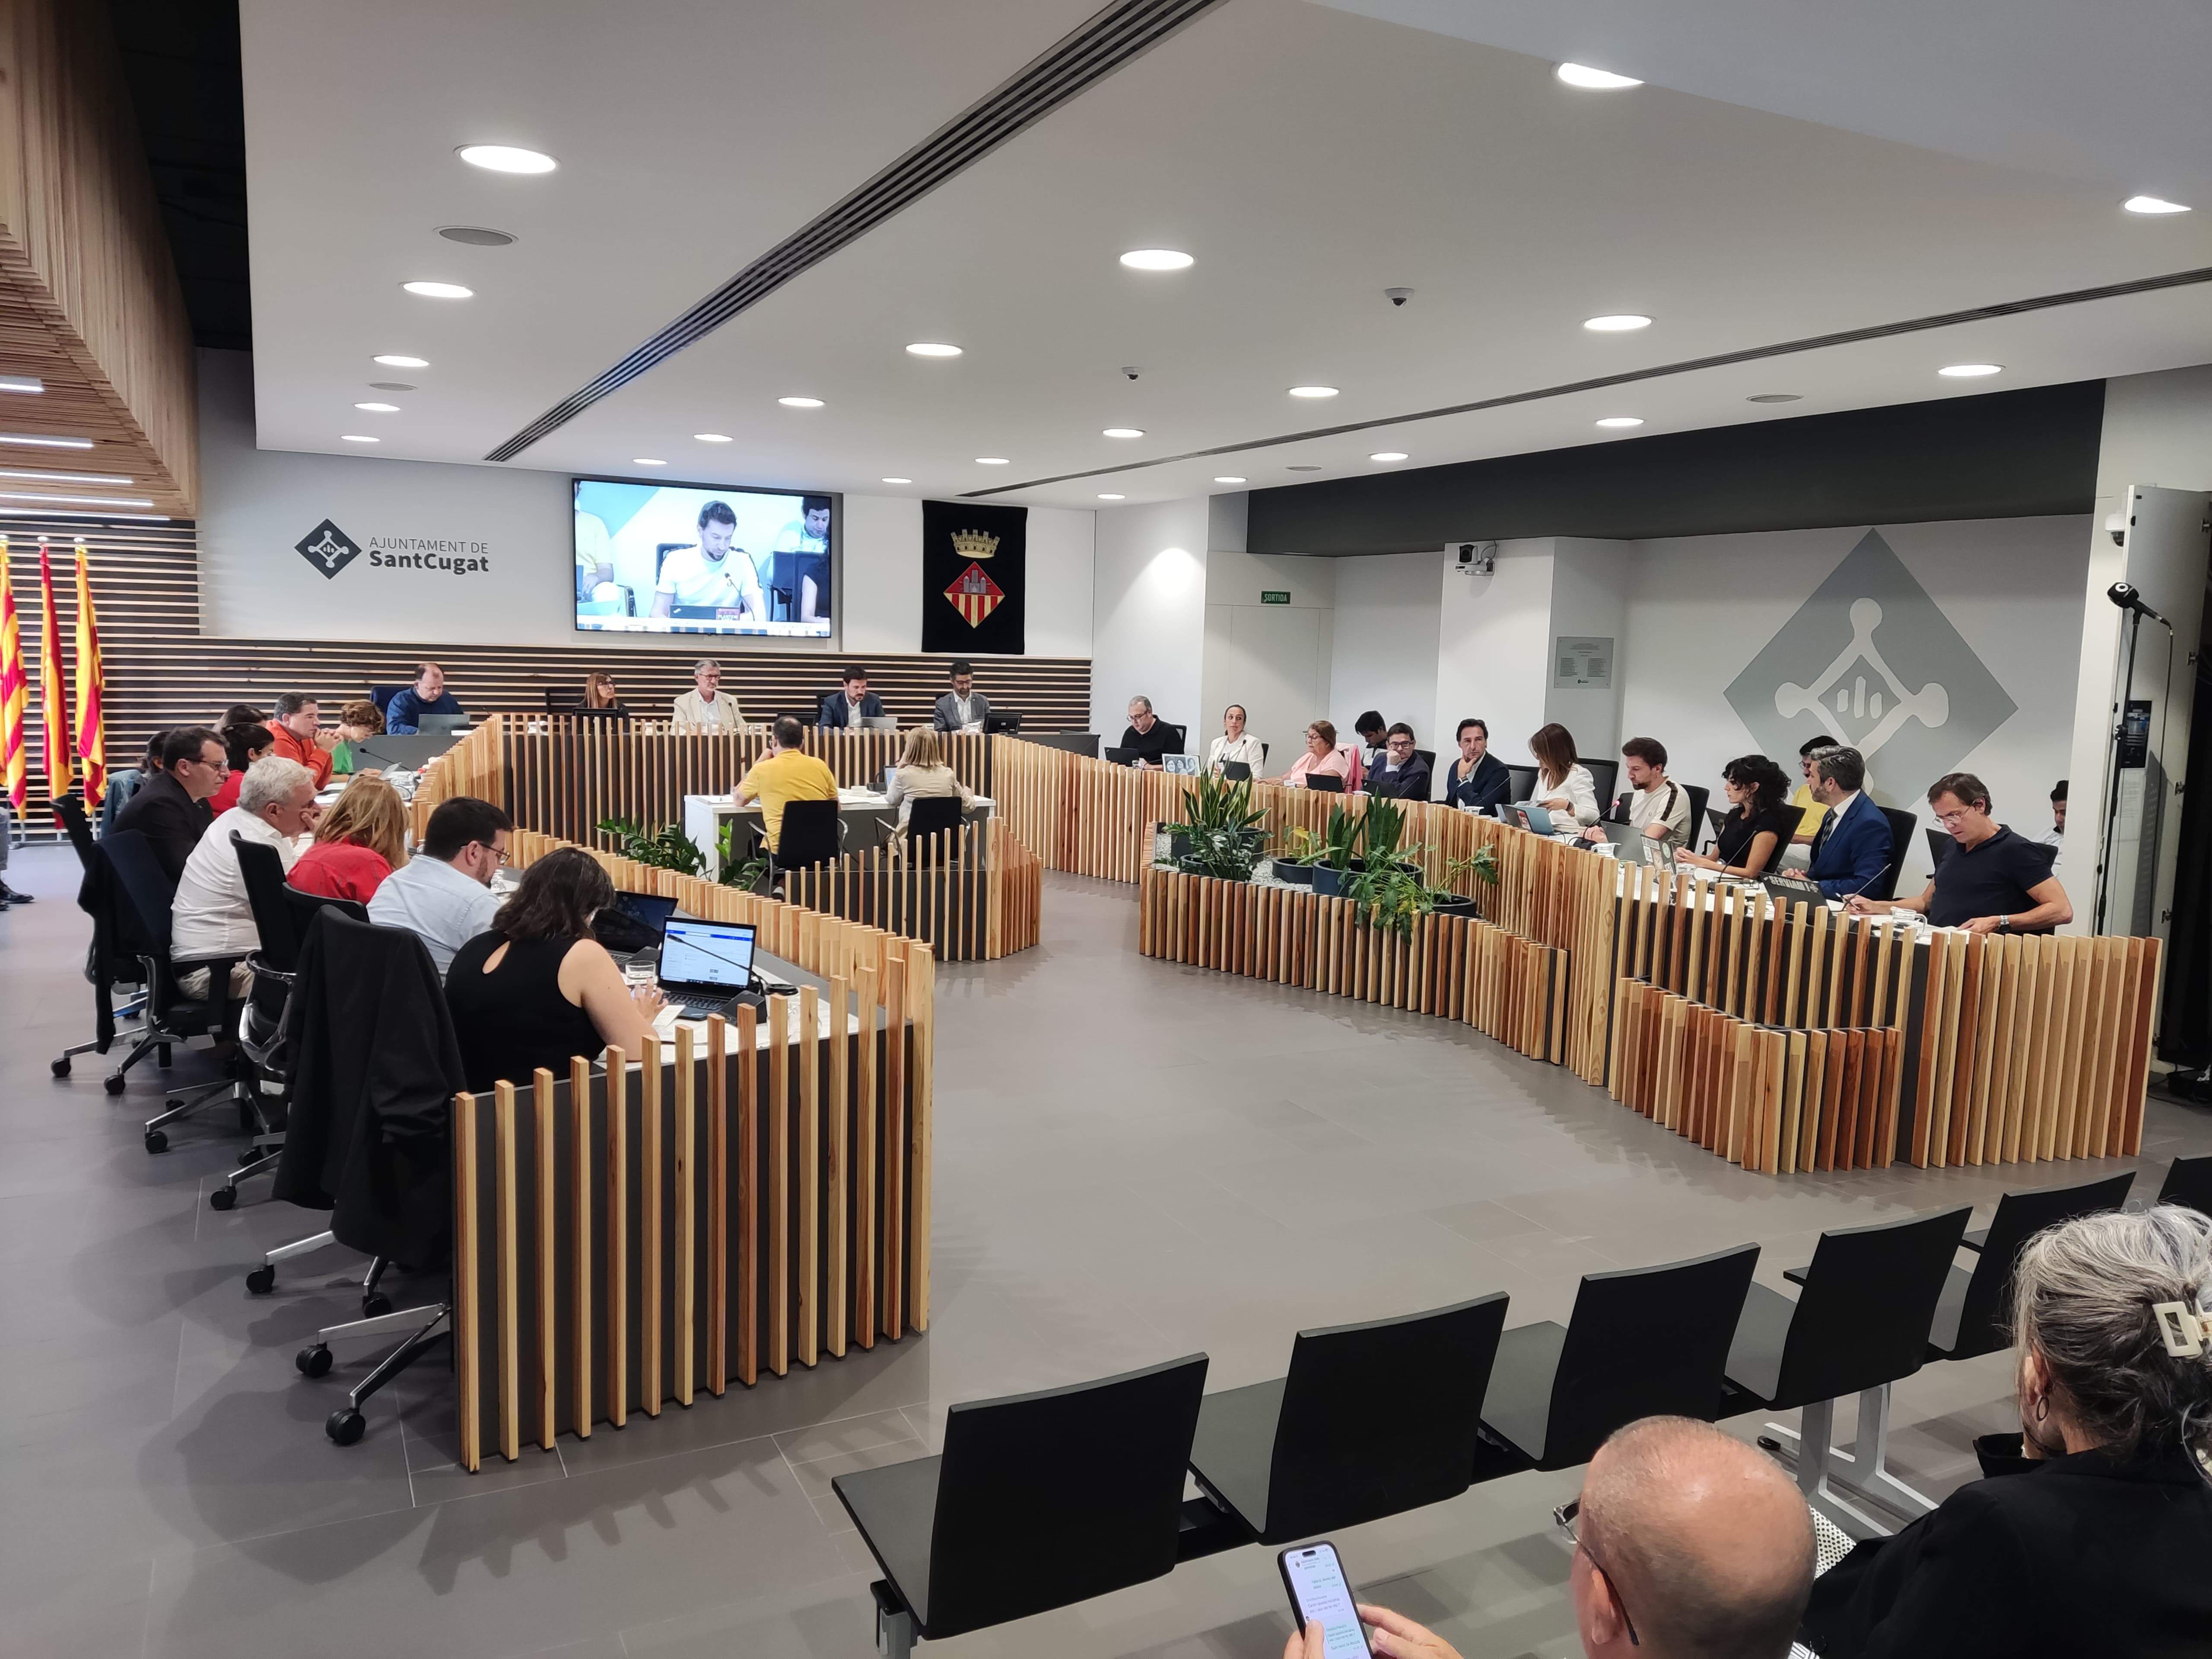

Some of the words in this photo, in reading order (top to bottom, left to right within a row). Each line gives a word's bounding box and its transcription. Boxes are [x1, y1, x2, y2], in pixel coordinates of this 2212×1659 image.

[369, 537, 466, 553] AJUNTAMENT
[471, 542, 489, 554] DE
[369, 550, 489, 575] SantCugat
[1264, 594, 1287, 602] SORTIDA
